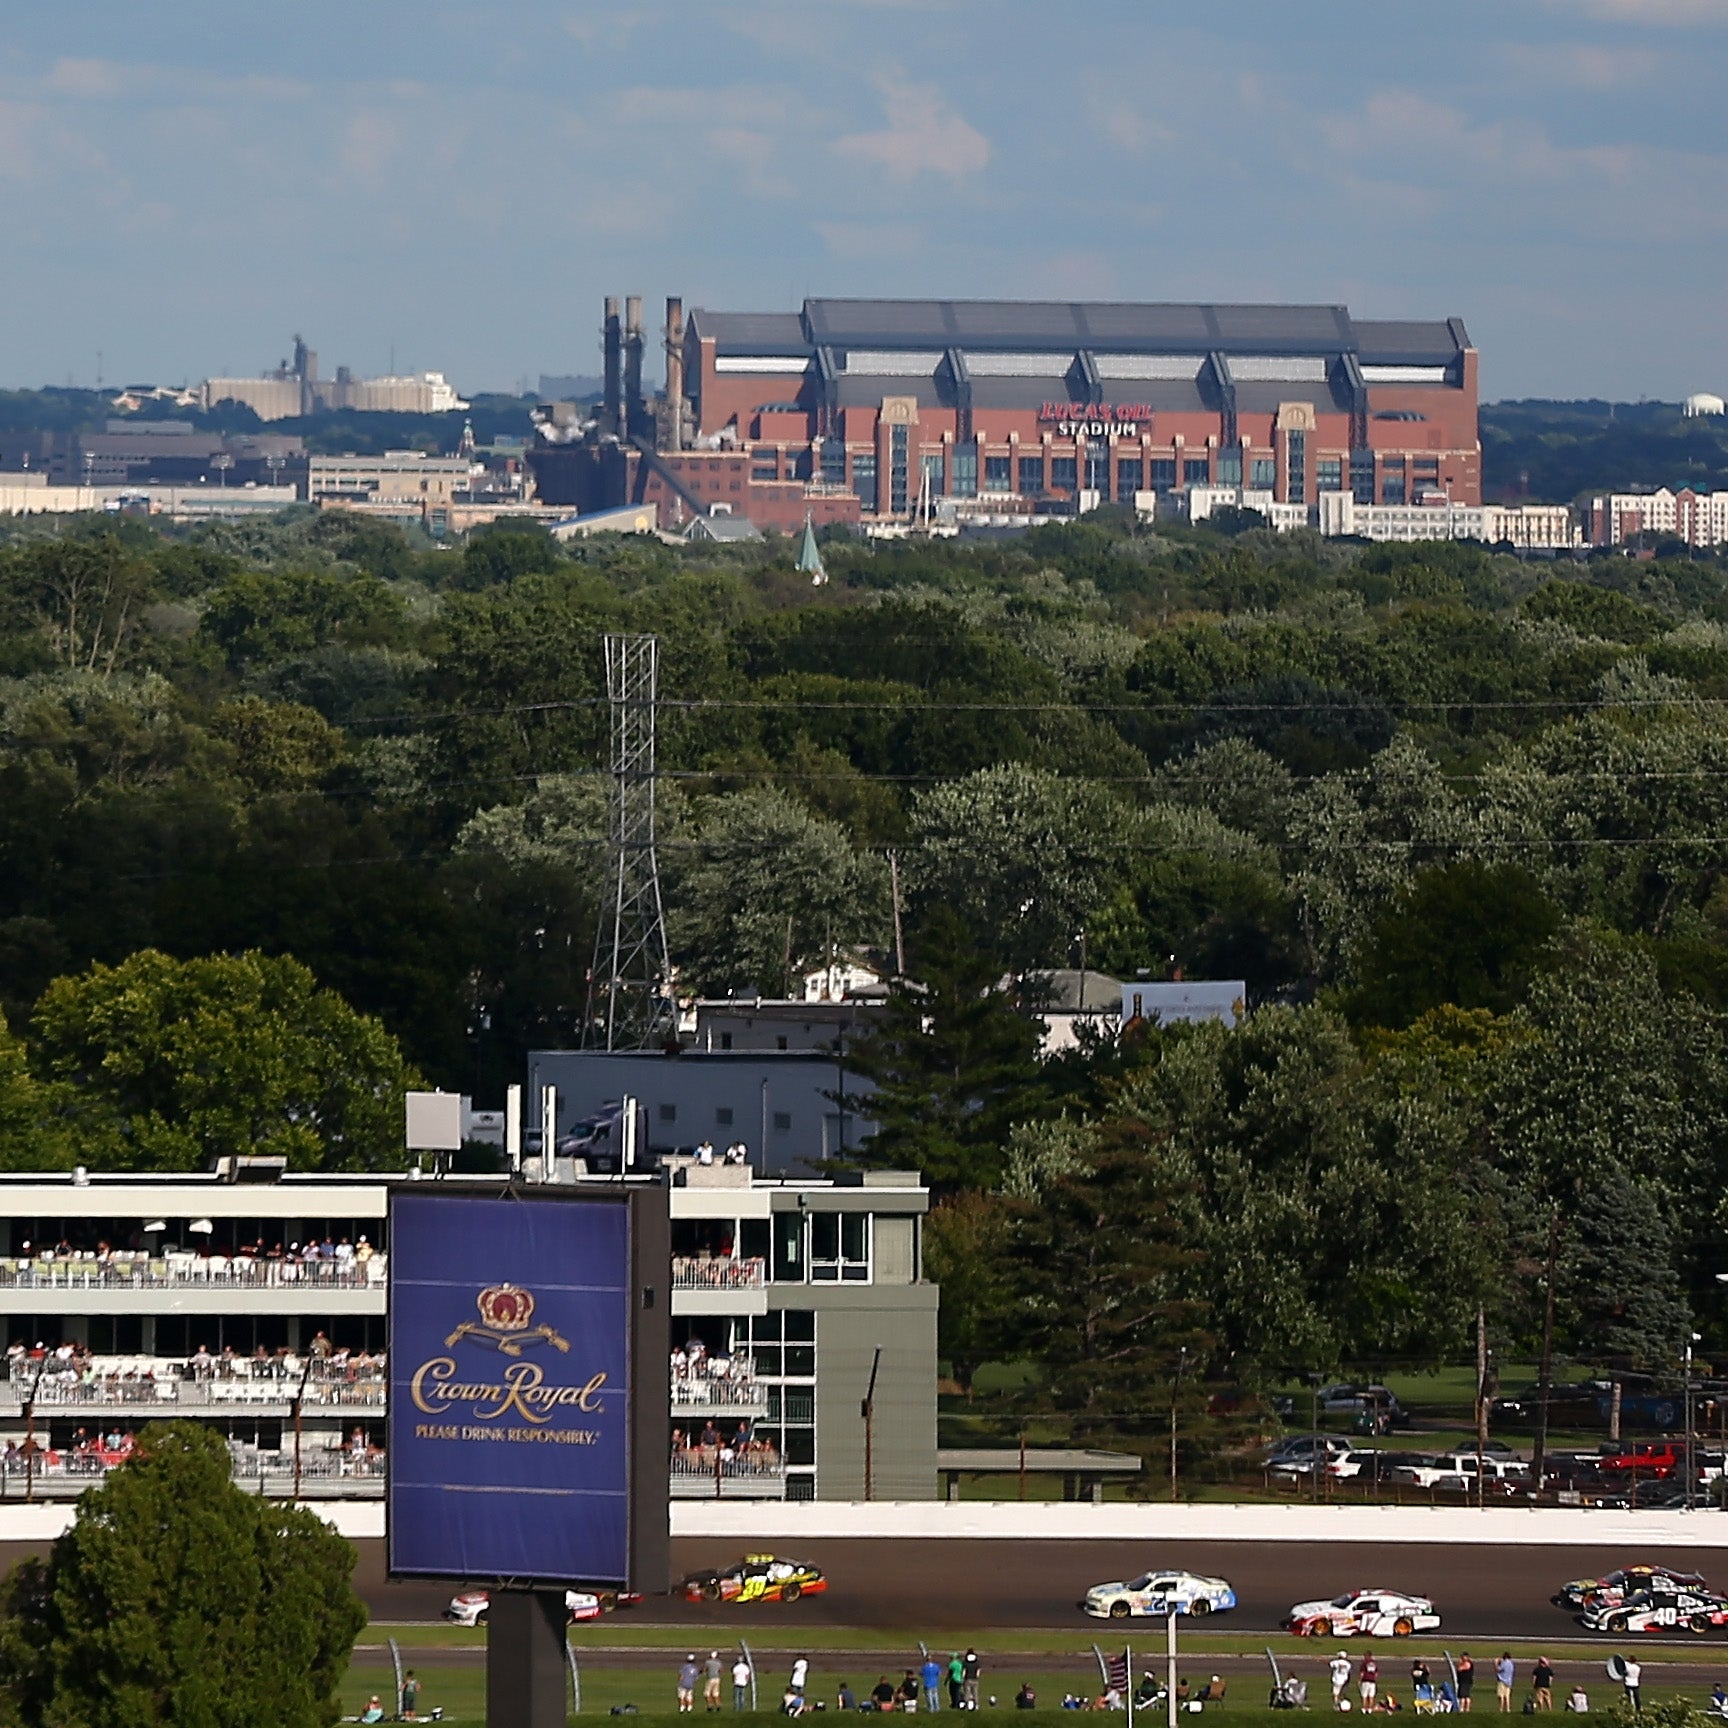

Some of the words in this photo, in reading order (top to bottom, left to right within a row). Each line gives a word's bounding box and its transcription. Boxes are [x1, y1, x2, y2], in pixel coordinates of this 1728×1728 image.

[1041, 402, 1112, 419] LUCAS
[1116, 404, 1154, 419] OIL
[1059, 421, 1136, 436] STADIUM
[410, 1357, 501, 1414] Crown
[473, 1362, 608, 1424] Royal
[415, 1424, 459, 1440] PLEASE
[462, 1425, 505, 1441] DRINK
[1653, 1607, 1677, 1626] 40
